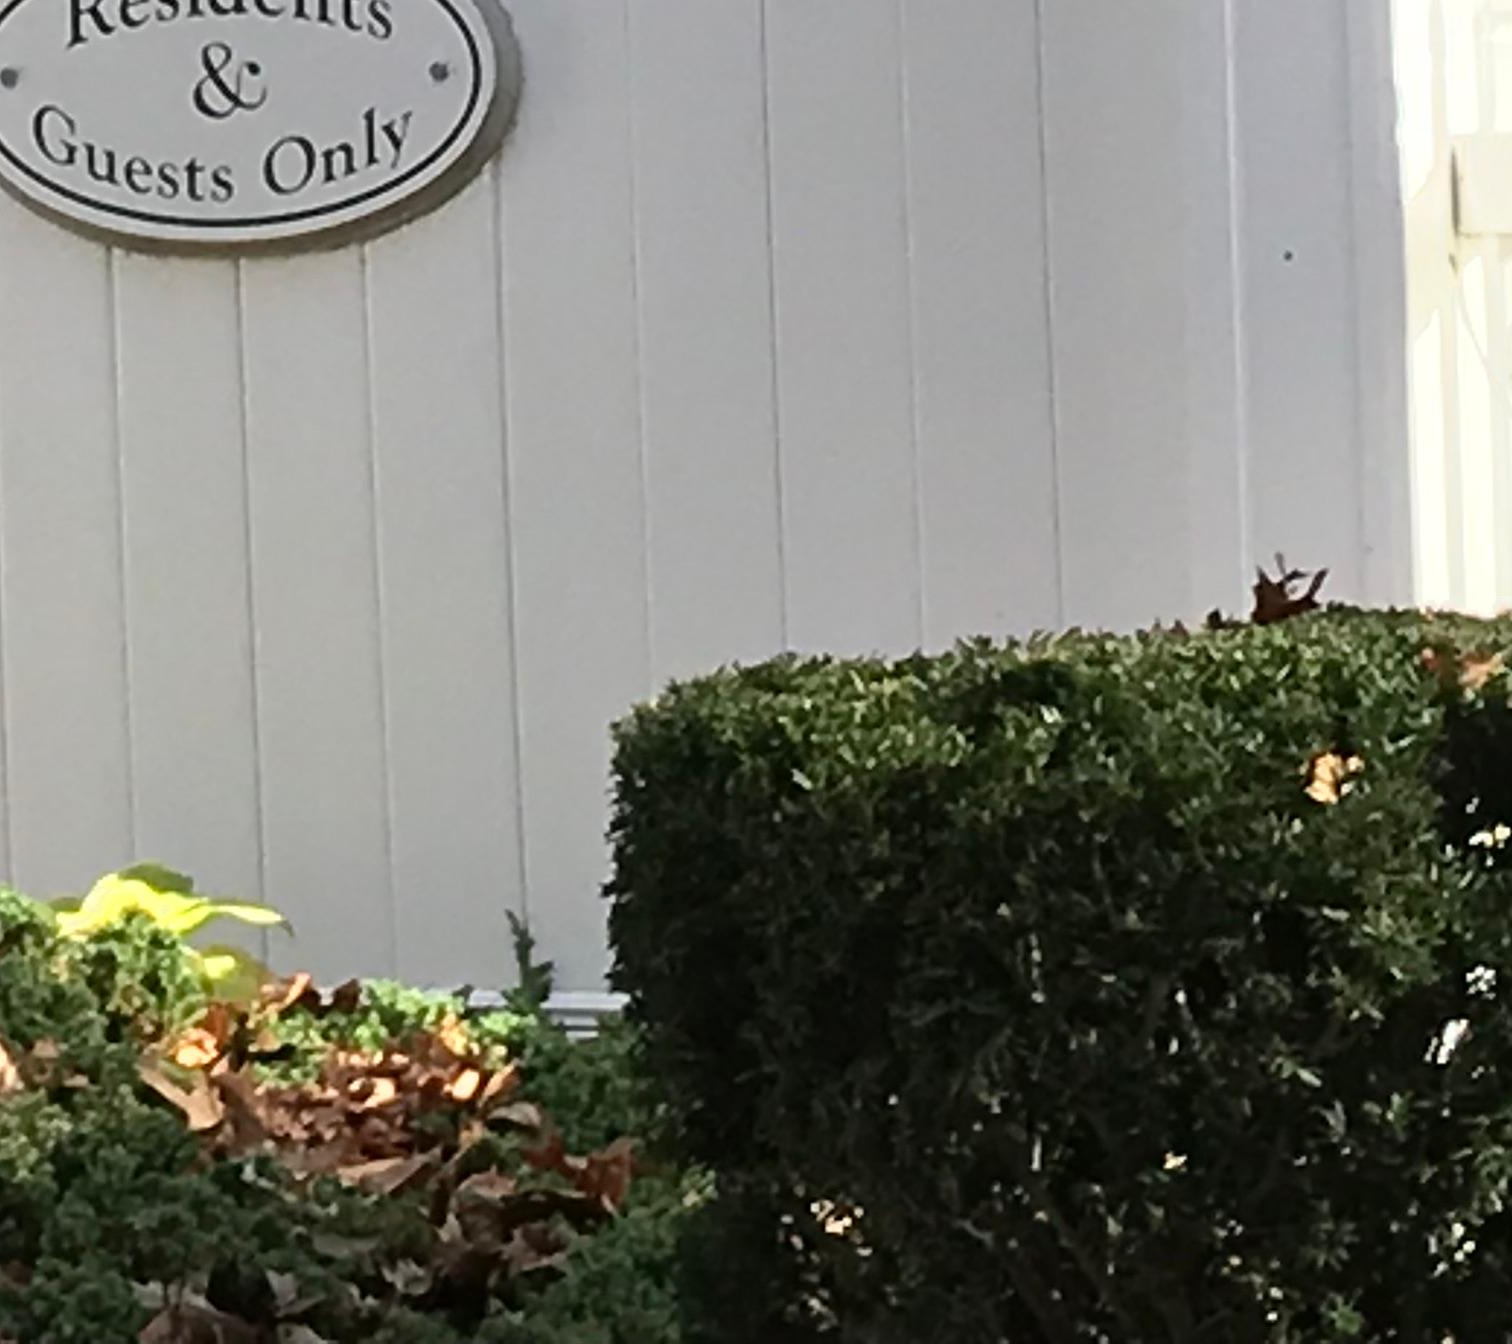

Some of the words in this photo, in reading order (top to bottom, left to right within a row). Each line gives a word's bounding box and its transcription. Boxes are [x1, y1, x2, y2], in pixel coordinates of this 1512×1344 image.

[192, 41, 268, 120] &
[33, 104, 235, 203] Guests
[263, 107, 413, 196] Only
